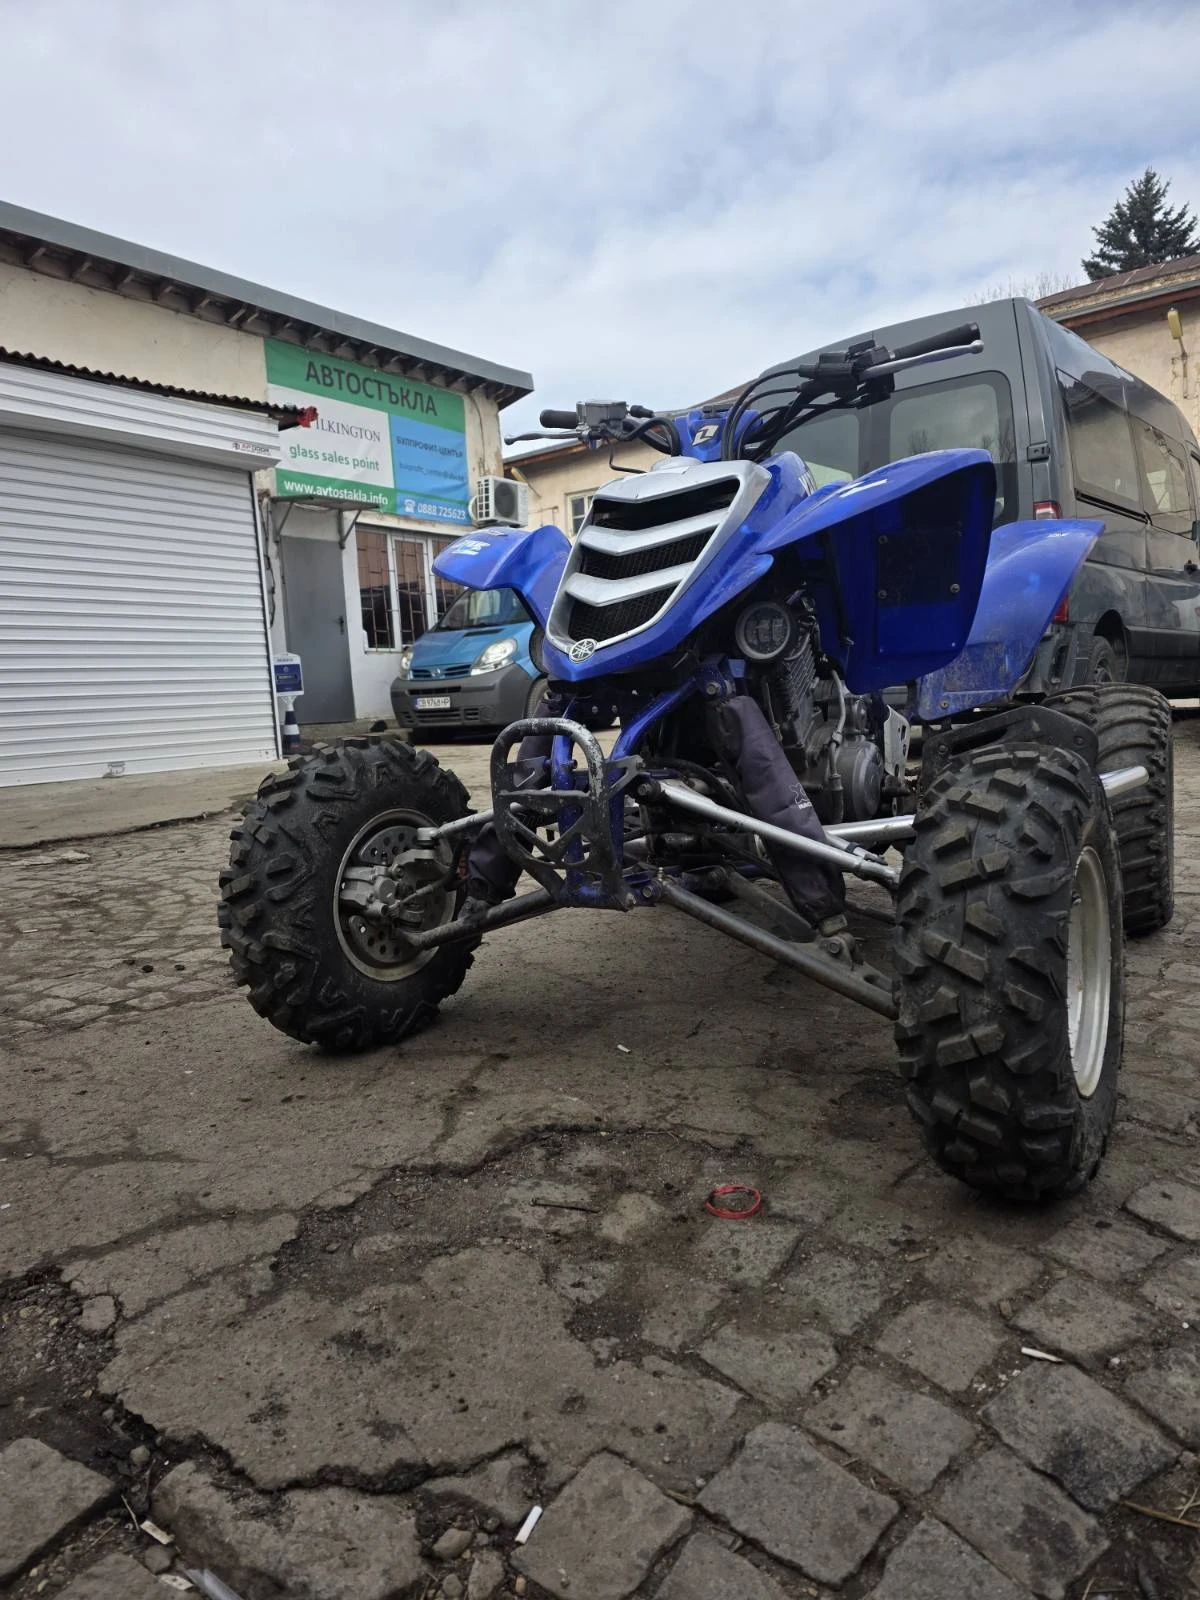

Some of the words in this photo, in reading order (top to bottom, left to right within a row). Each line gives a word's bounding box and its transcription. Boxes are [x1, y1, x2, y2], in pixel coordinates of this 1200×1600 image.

[306, 360, 438, 417] АВТОСТЪКЛА
[313, 418, 381, 442] ILKINGTON
[289, 444, 319, 460] glass
[321, 451, 350, 466] sales
[352, 457, 380, 471] point
[283, 480, 389, 505] www.avtostakla.info
[417, 503, 438, 515] 0888
